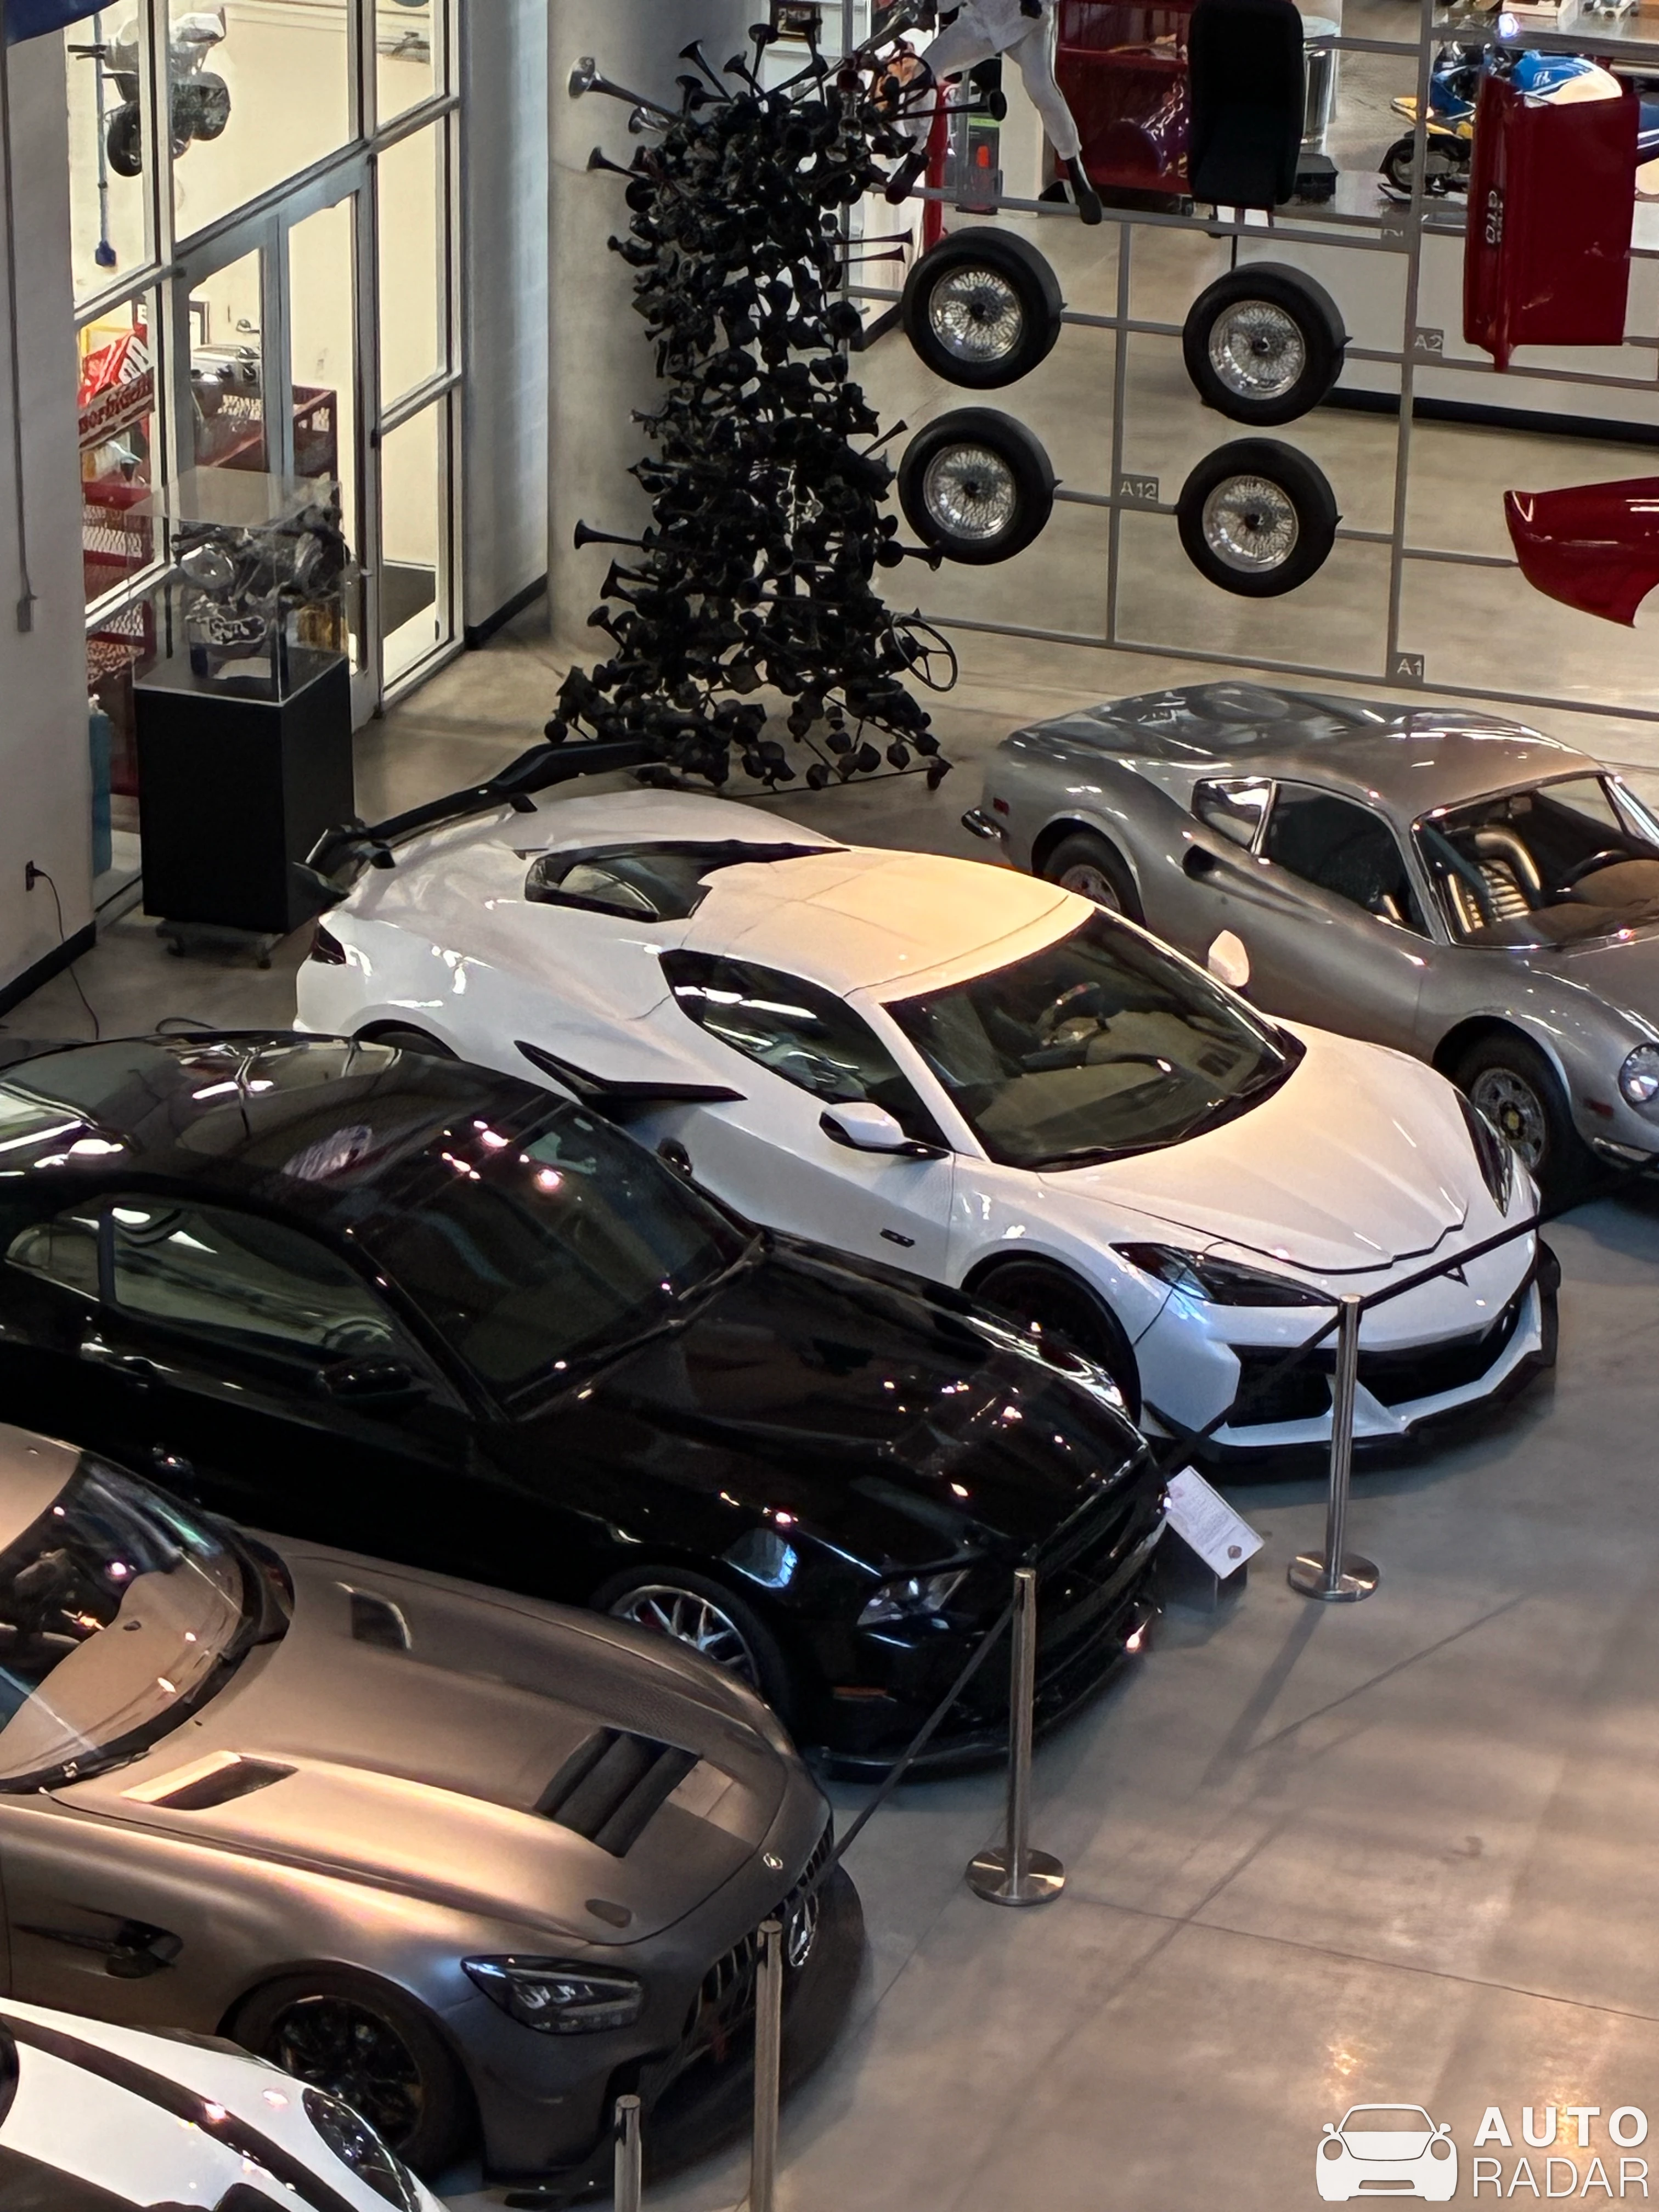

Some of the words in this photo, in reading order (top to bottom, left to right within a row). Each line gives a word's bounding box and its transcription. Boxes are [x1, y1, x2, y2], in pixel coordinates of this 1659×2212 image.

[1414, 333, 1443, 352] A2
[1120, 481, 1157, 500] A12
[1397, 658, 1422, 676] A1
